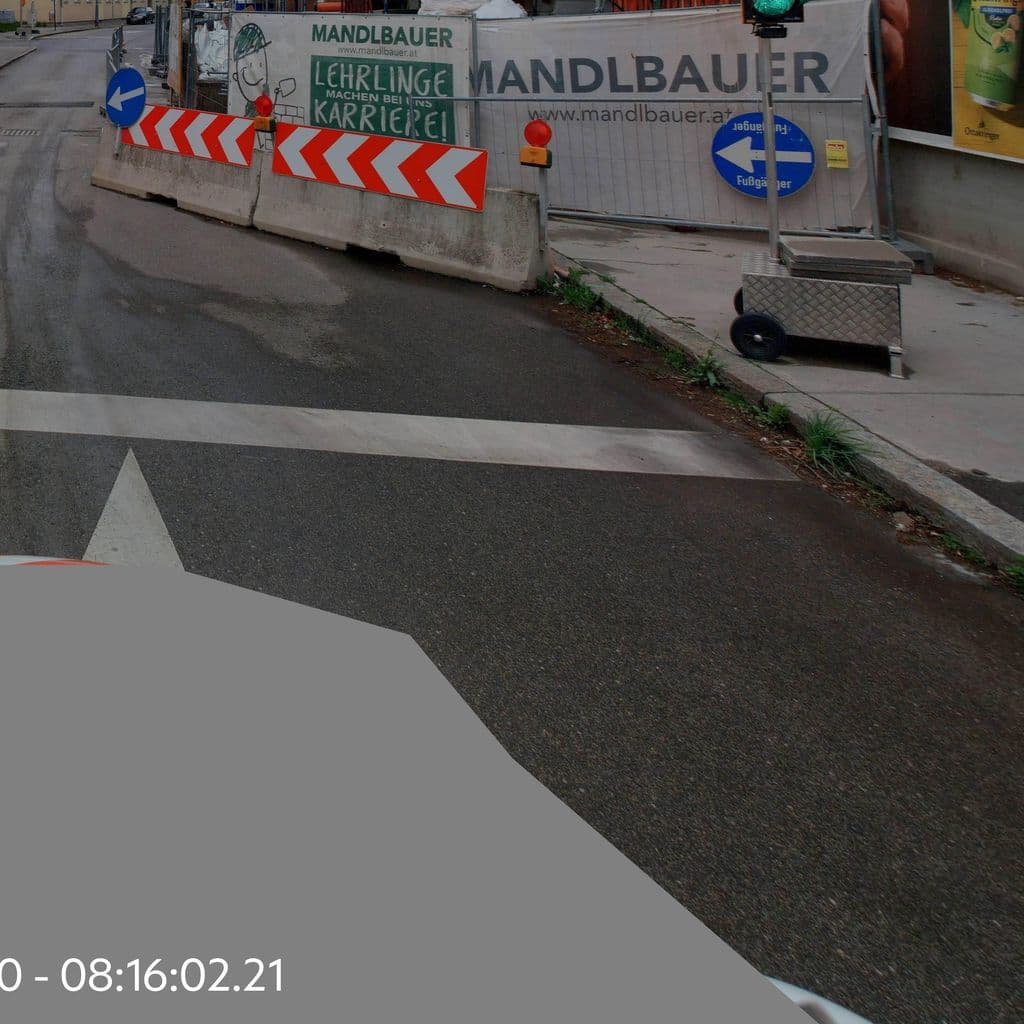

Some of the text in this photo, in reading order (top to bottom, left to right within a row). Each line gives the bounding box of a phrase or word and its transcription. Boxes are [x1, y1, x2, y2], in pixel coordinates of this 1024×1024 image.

[311, 23, 454, 49] MANDLBAUER
[337, 45, 418, 58] www.mandlbauer.at
[315, 60, 448, 97] LEHRLINGE
[469, 50, 831, 94] MANDLBAUER
[326, 89, 379, 103] MACHEN
[383, 94, 403, 105] BEI
[314, 98, 447, 142] KARRIERE!
[527, 103, 733, 125] www.mandlbauer.at
[736, 175, 793, 191] Fußgäger
